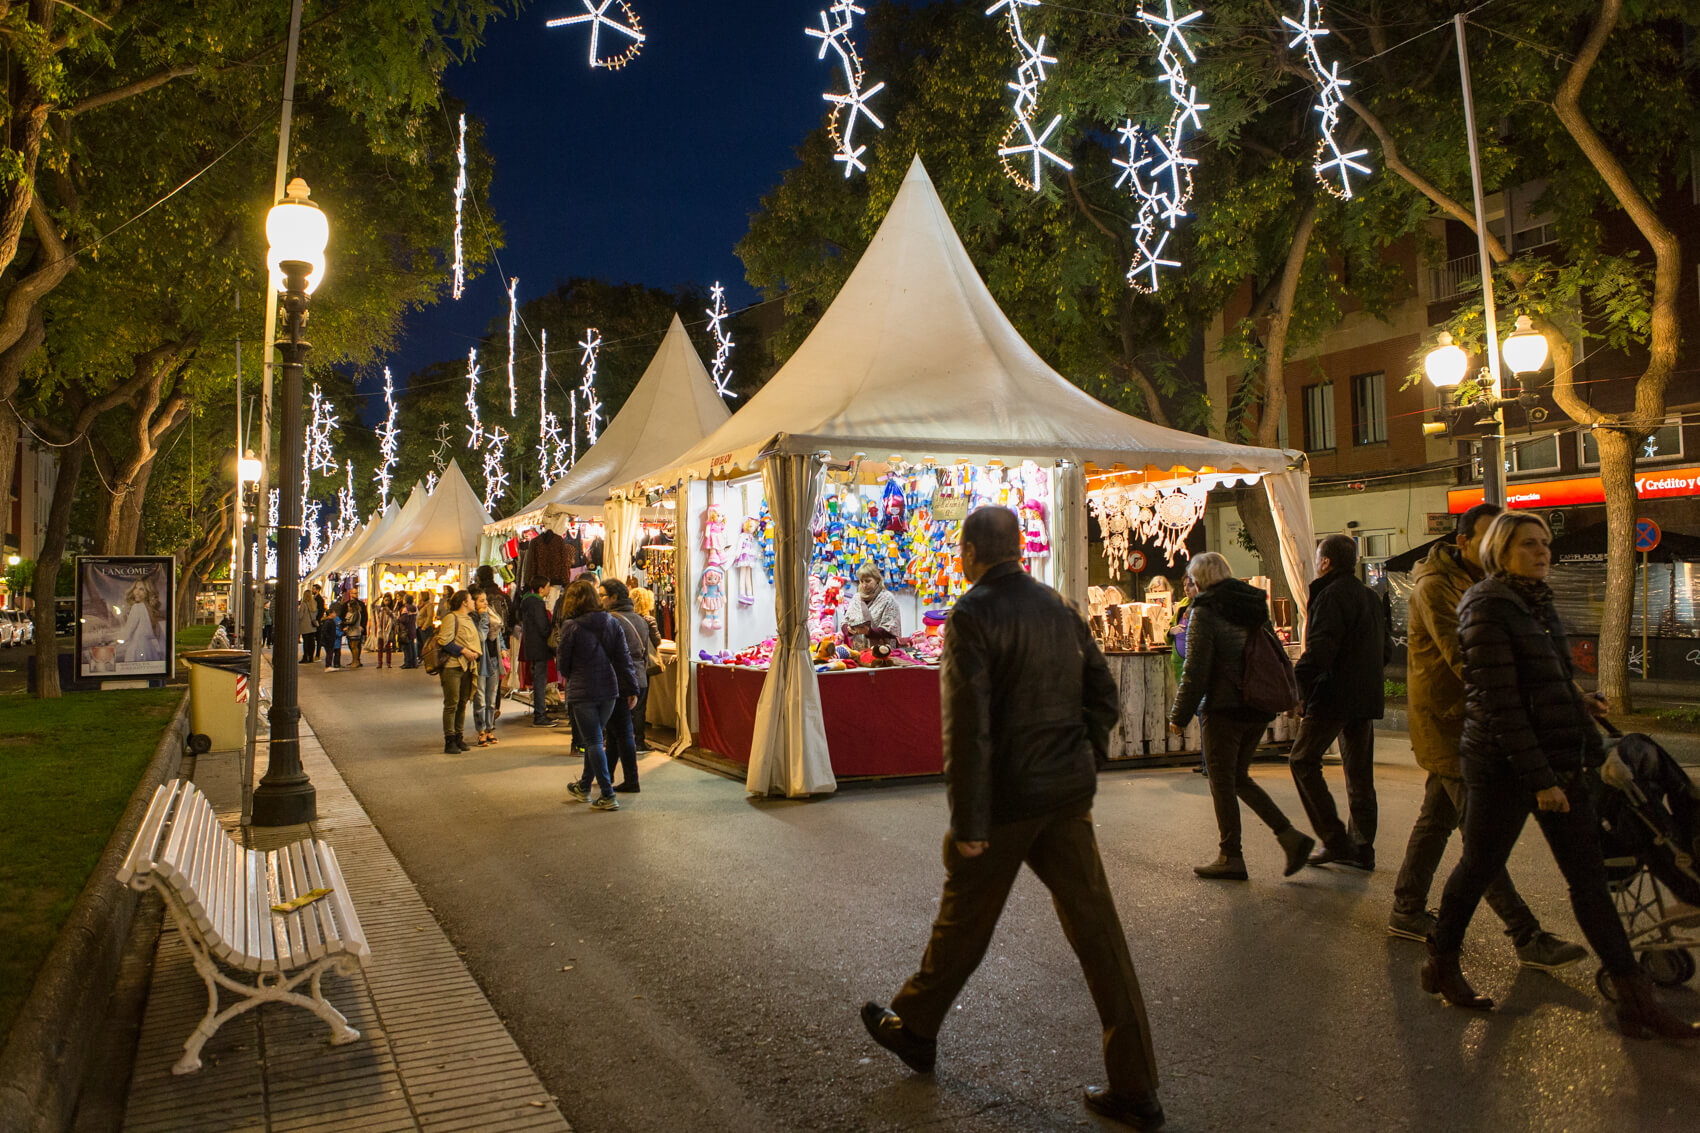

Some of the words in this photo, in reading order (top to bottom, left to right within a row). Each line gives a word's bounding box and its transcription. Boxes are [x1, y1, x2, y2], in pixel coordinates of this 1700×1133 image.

[1645, 478, 1687, 490] Crédito
[1687, 478, 1696, 489] y
[102, 566, 149, 576] LANCÔME
